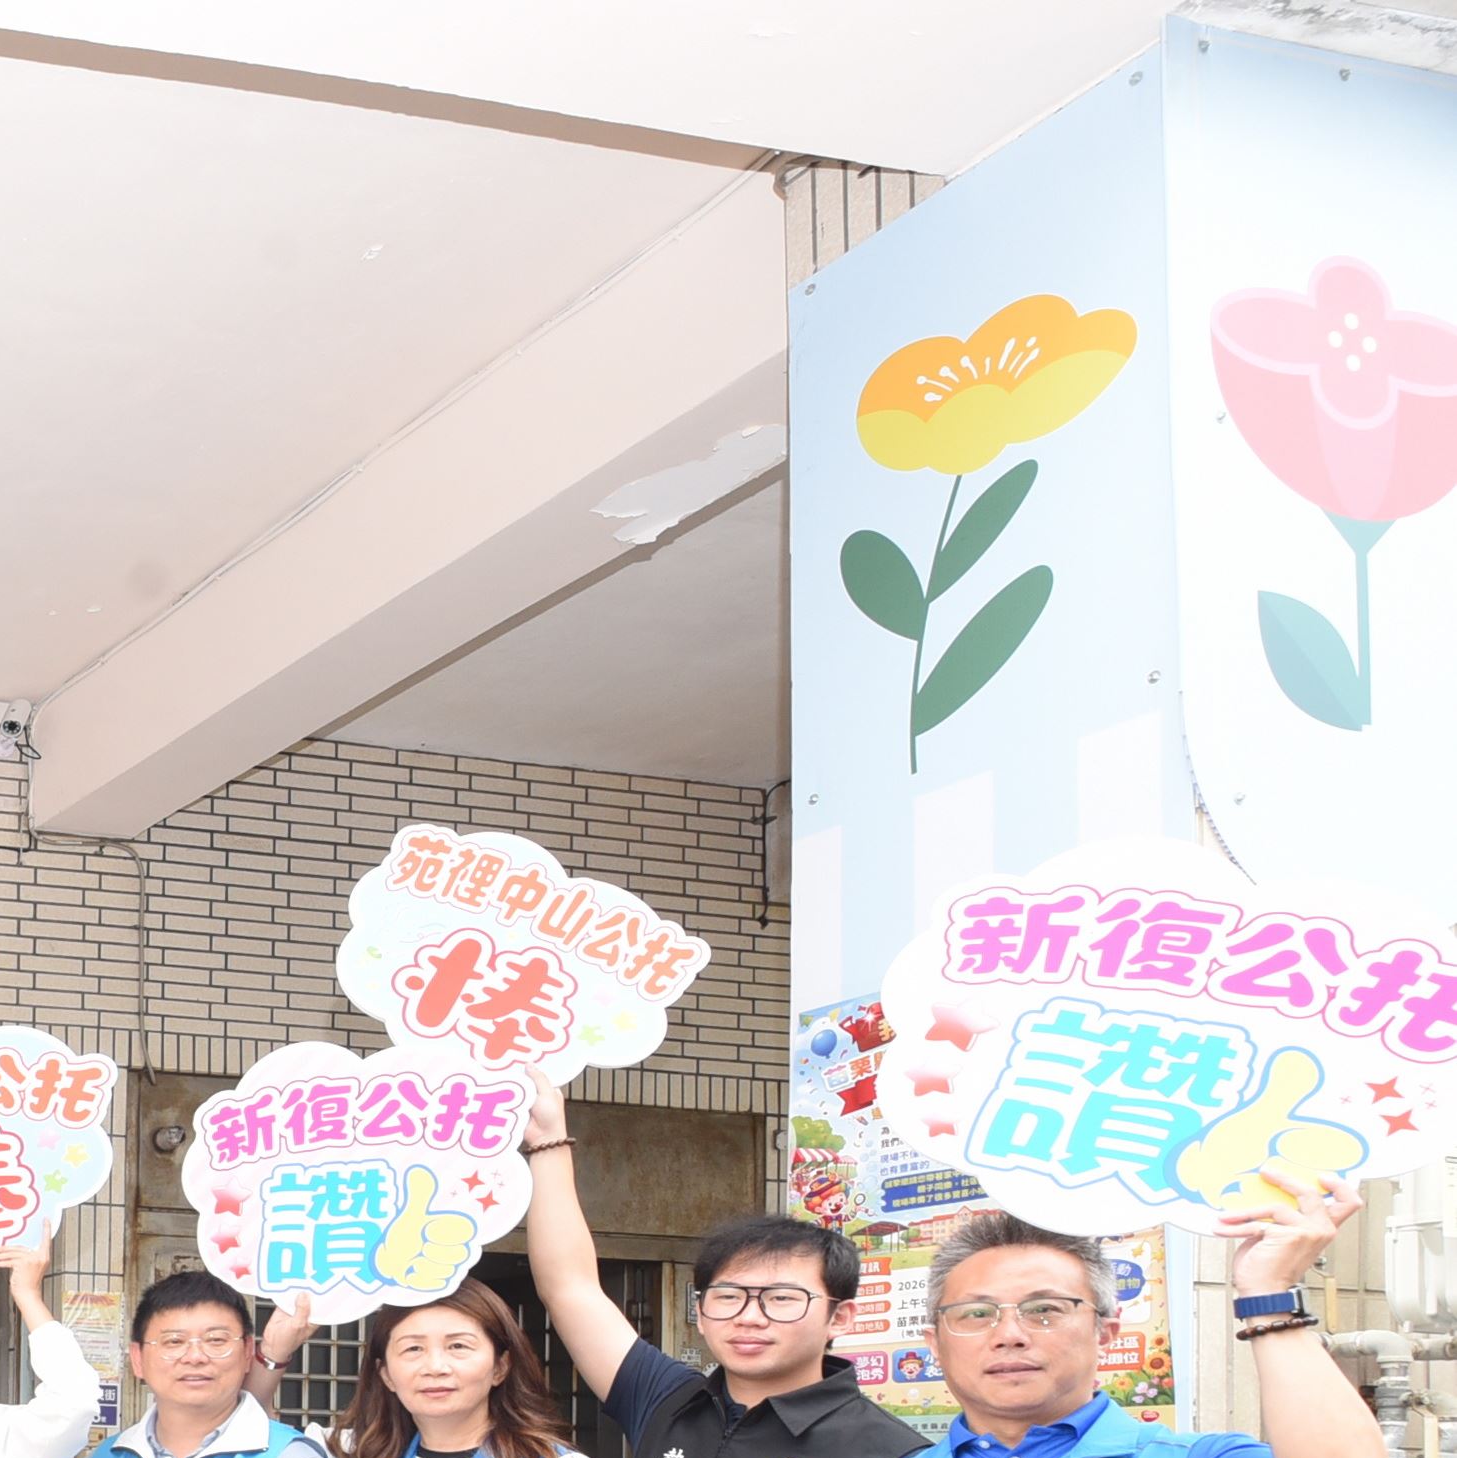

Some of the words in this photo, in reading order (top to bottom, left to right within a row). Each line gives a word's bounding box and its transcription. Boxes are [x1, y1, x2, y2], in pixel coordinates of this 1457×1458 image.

[392, 834, 696, 996] 苑裡中山公托
[958, 897, 1457, 1053] 新復公托
[404, 938, 565, 1061] 棒
[210, 1082, 515, 1162] 新復公托
[985, 1010, 1237, 1189] 讚
[266, 1169, 388, 1289] 讚
[898, 1280, 926, 1292] 2026
